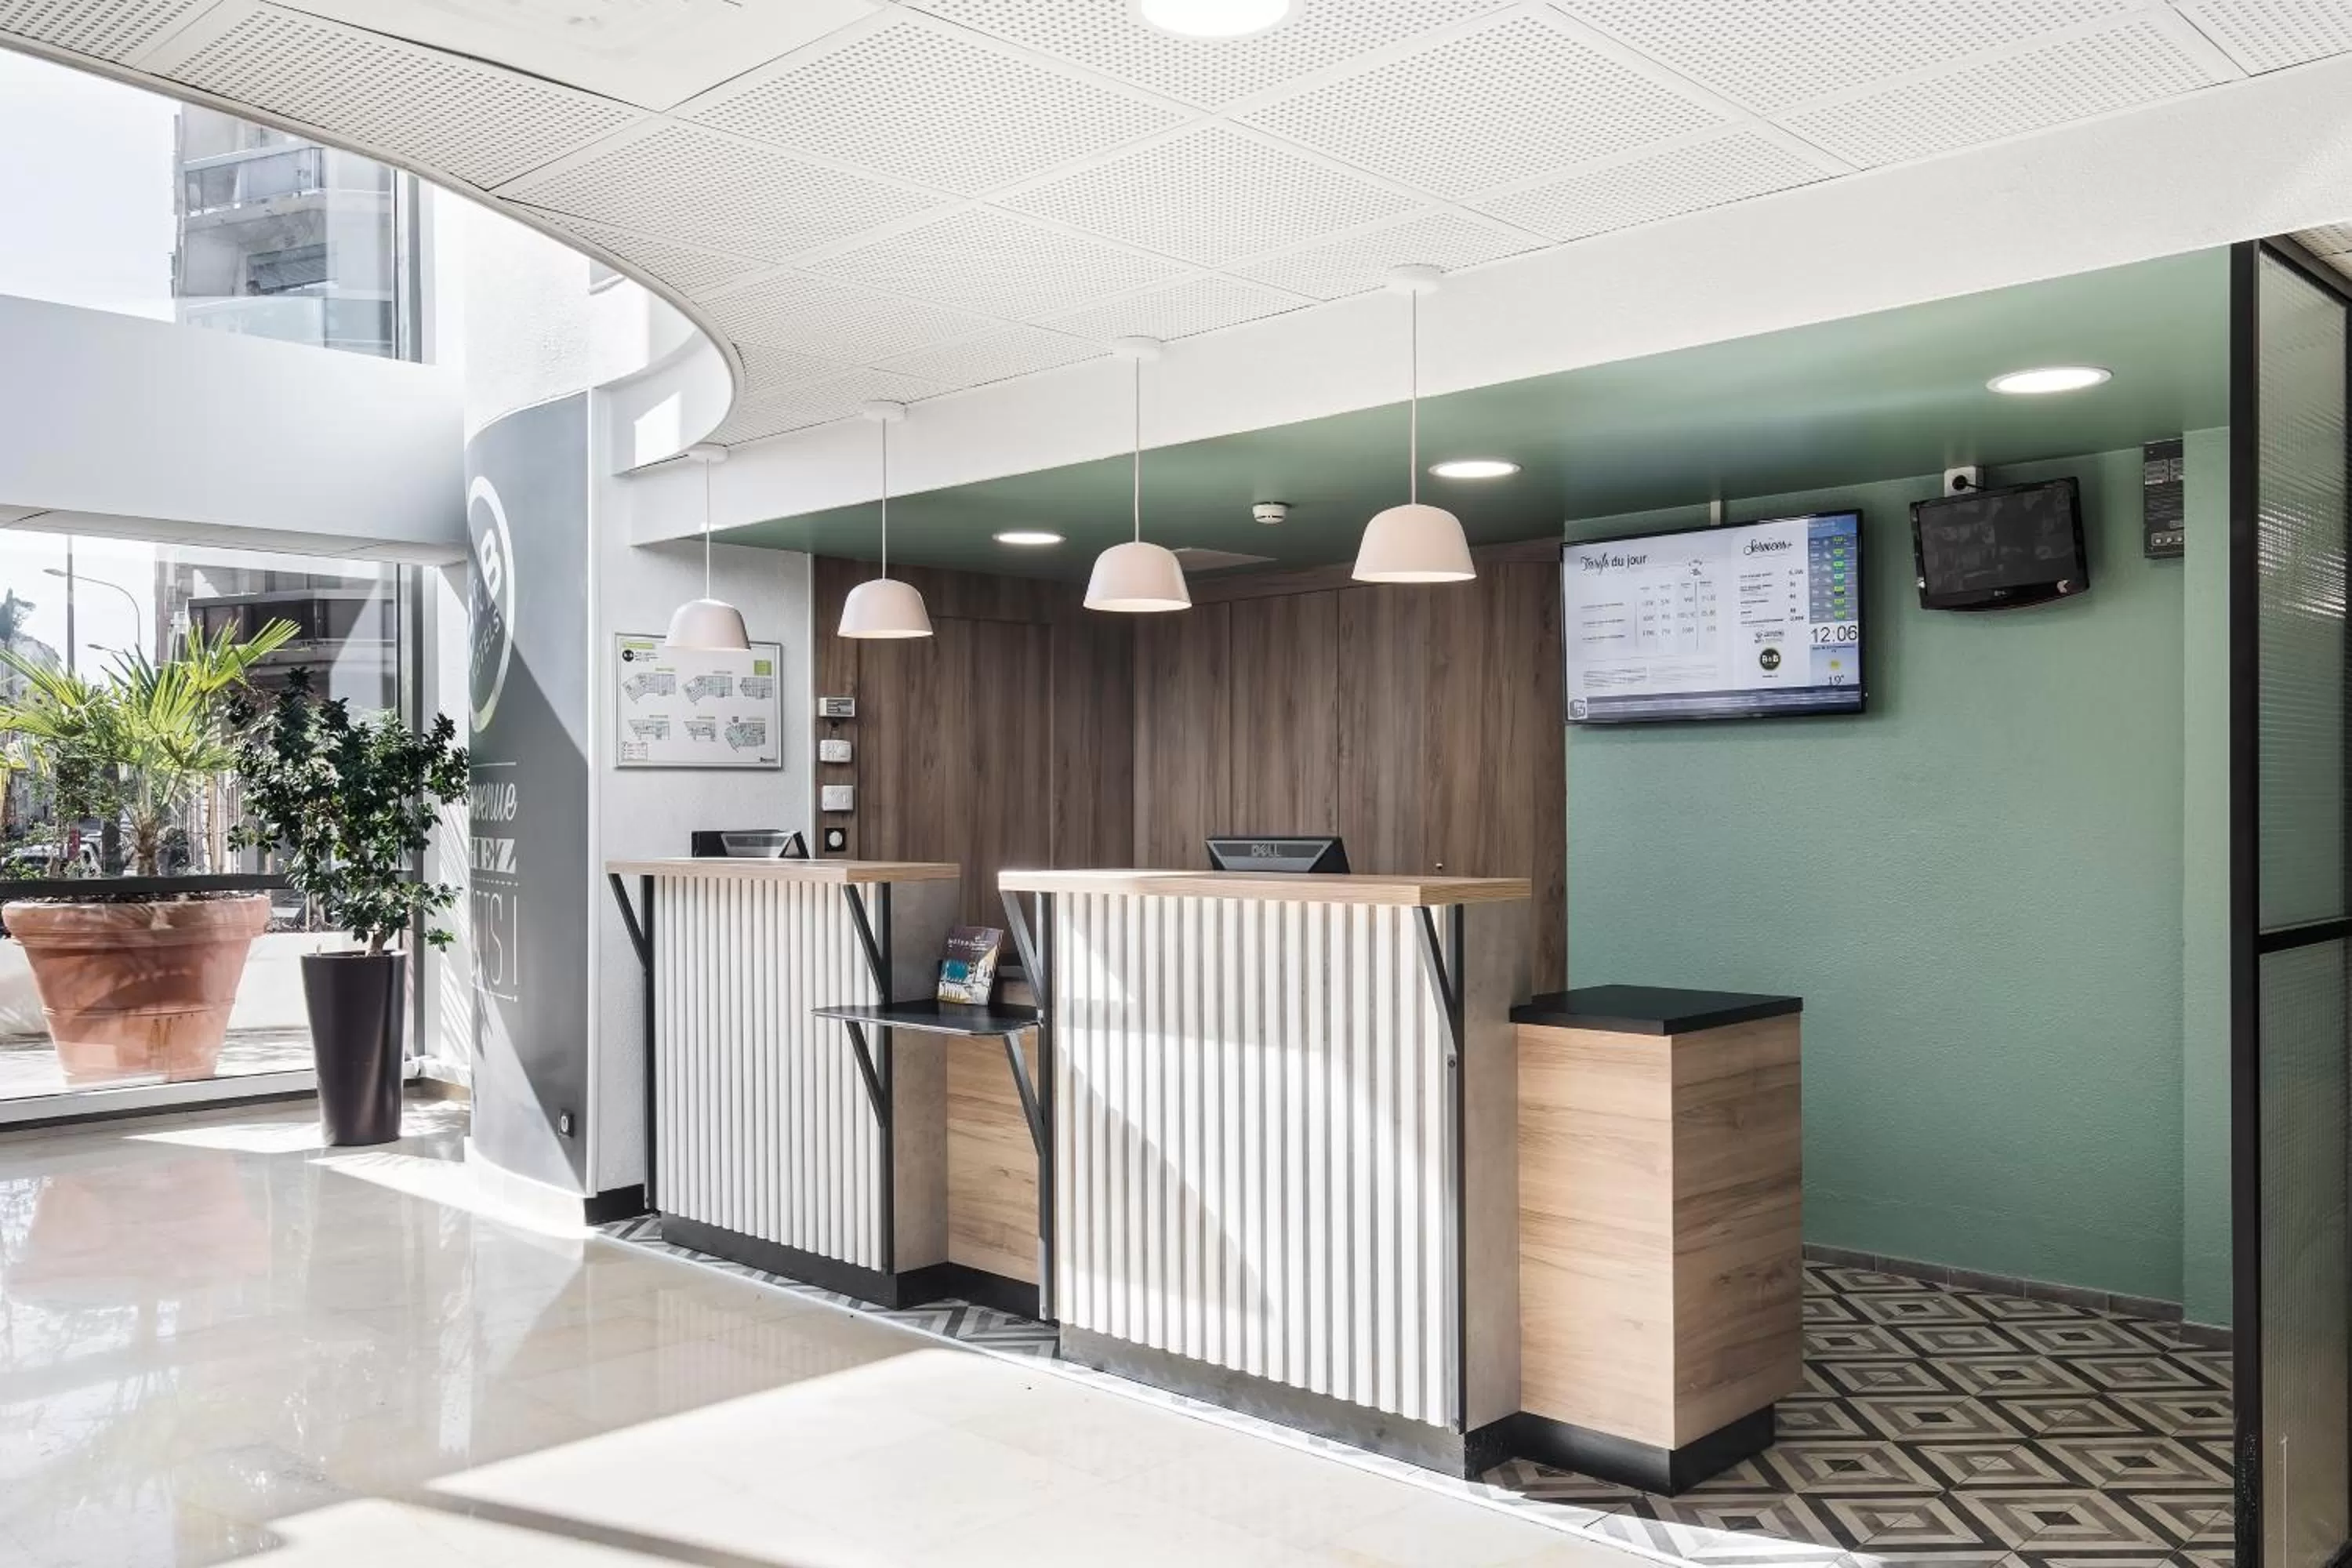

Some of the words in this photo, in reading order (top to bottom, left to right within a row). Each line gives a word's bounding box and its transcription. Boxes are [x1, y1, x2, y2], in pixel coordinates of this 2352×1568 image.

[1612, 556, 1624, 567] du
[1627, 554, 1648, 568] jour
[1811, 625, 1858, 643] 12:06
[1251, 843, 1281, 857] DELL
